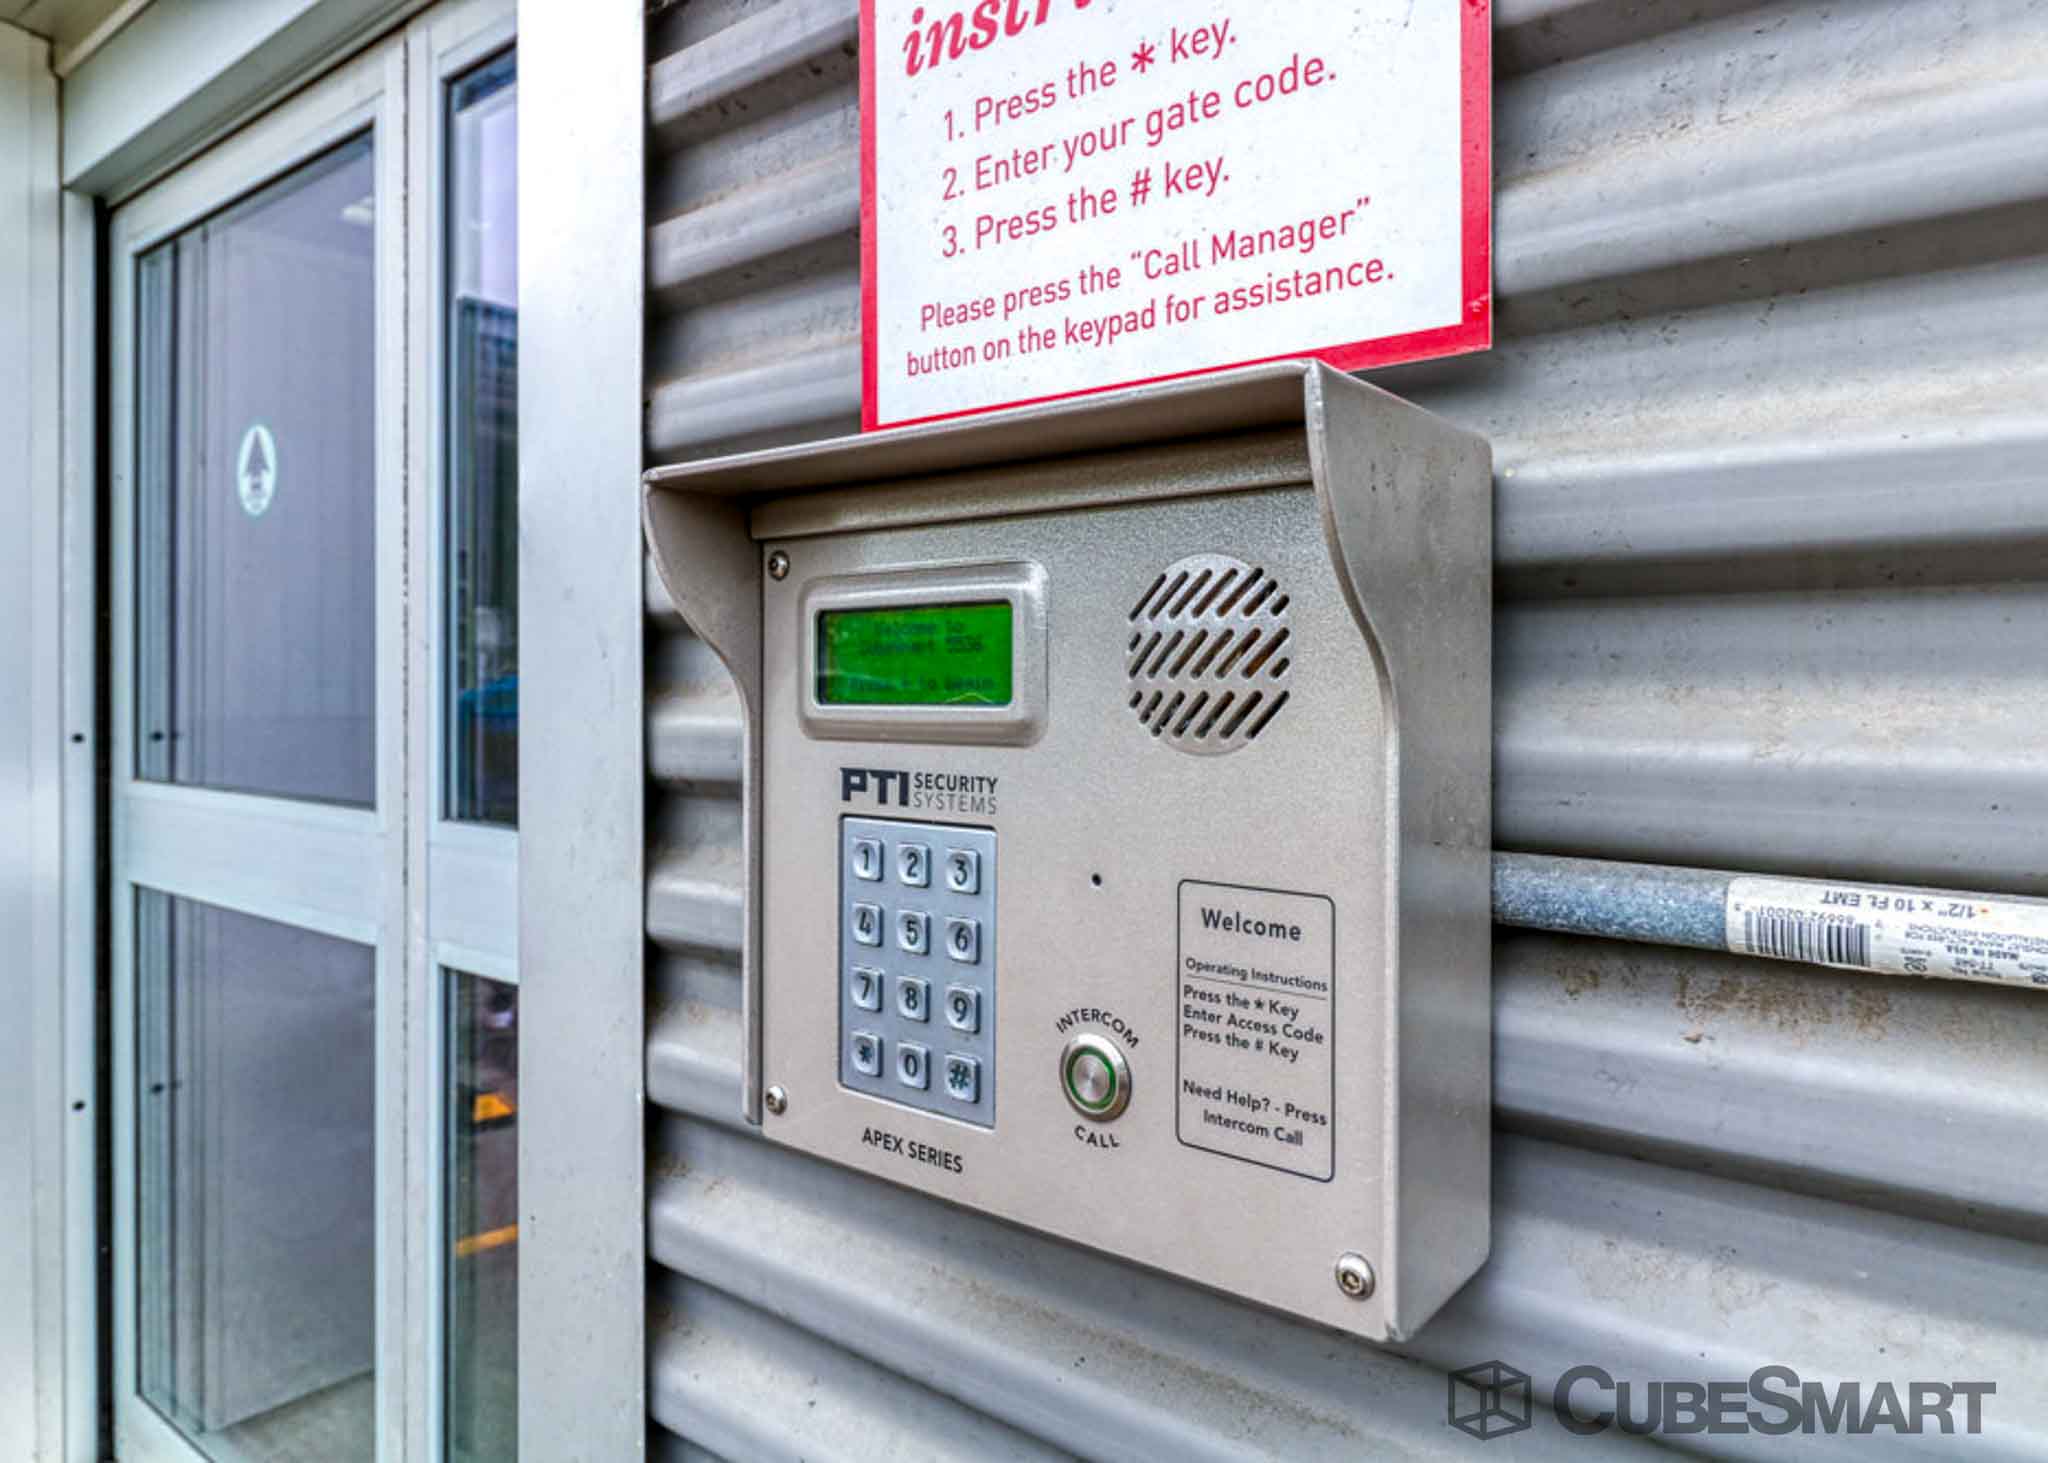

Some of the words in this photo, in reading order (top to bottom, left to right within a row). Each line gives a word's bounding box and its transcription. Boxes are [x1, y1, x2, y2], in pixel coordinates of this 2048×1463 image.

[903, 0, 1092, 76] inst
[945, 112, 964, 139] 1.
[976, 82, 1056, 129] Press
[1068, 61, 1117, 98] the
[1171, 18, 1236, 62] key.
[943, 167, 964, 200] 2.
[976, 144, 1054, 190] Enter
[1062, 117, 1135, 170] your
[1146, 91, 1221, 147] gate
[1234, 55, 1335, 108] code.
[943, 225, 964, 256] 3.
[976, 206, 1057, 247] Press
[1068, 187, 1118, 224] the
[1131, 169, 1152, 206] #
[1165, 156, 1229, 196] key.
[907, 346, 976, 376] button
[984, 338, 1010, 360] on
[1018, 328, 1056, 353] the
[1064, 299, 1156, 346] keypad
[1165, 294, 1206, 324] for
[1214, 259, 1392, 314] assistance.
[921, 296, 995, 329] Please
[1003, 279, 1071, 315] press
[1079, 268, 1120, 294] the
[840, 767, 910, 806] PTI
[913, 772, 998, 794] SECURITY
[913, 791, 998, 815] SYSTEMS
[862, 848, 870, 871] 1
[906, 852, 918, 877] 2
[954, 858, 968, 886] 3
[1821, 890, 1861, 907] EMT
[1894, 898, 1916, 912] 10
[859, 911, 872, 934] 4
[905, 920, 918, 945] 5
[955, 926, 968, 952] 6
[1201, 907, 1301, 941] Welcome
[1186, 957, 1247, 981] Operating
[1251, 968, 1328, 992] Instructions
[861, 975, 872, 1000] 7
[905, 986, 917, 1011] 8
[953, 997, 967, 1022] 9
[1184, 985, 1221, 1004] Press
[1226, 992, 1250, 1009] the
[1269, 1000, 1299, 1021] Key
[1056, 1008, 1139, 1048] INTERCOM
[1184, 1005, 1222, 1024] Enter
[1227, 1014, 1277, 1035] Access
[1282, 1024, 1324, 1044] Code
[1184, 1024, 1221, 1044] Press
[1225, 1033, 1250, 1049] the
[1269, 1041, 1299, 1063] Key
[905, 1053, 917, 1078] 0
[950, 1064, 970, 1090] #
[1183, 1080, 1222, 1101] Need
[1227, 1089, 1271, 1112] Help?
[1285, 1103, 1328, 1126] Press
[1074, 1124, 1120, 1148] CALL
[1203, 1109, 1269, 1138] Intercom
[1274, 1126, 1303, 1146] Call
[862, 1127, 904, 1155] APEX
[908, 1142, 964, 1174] SERIES
